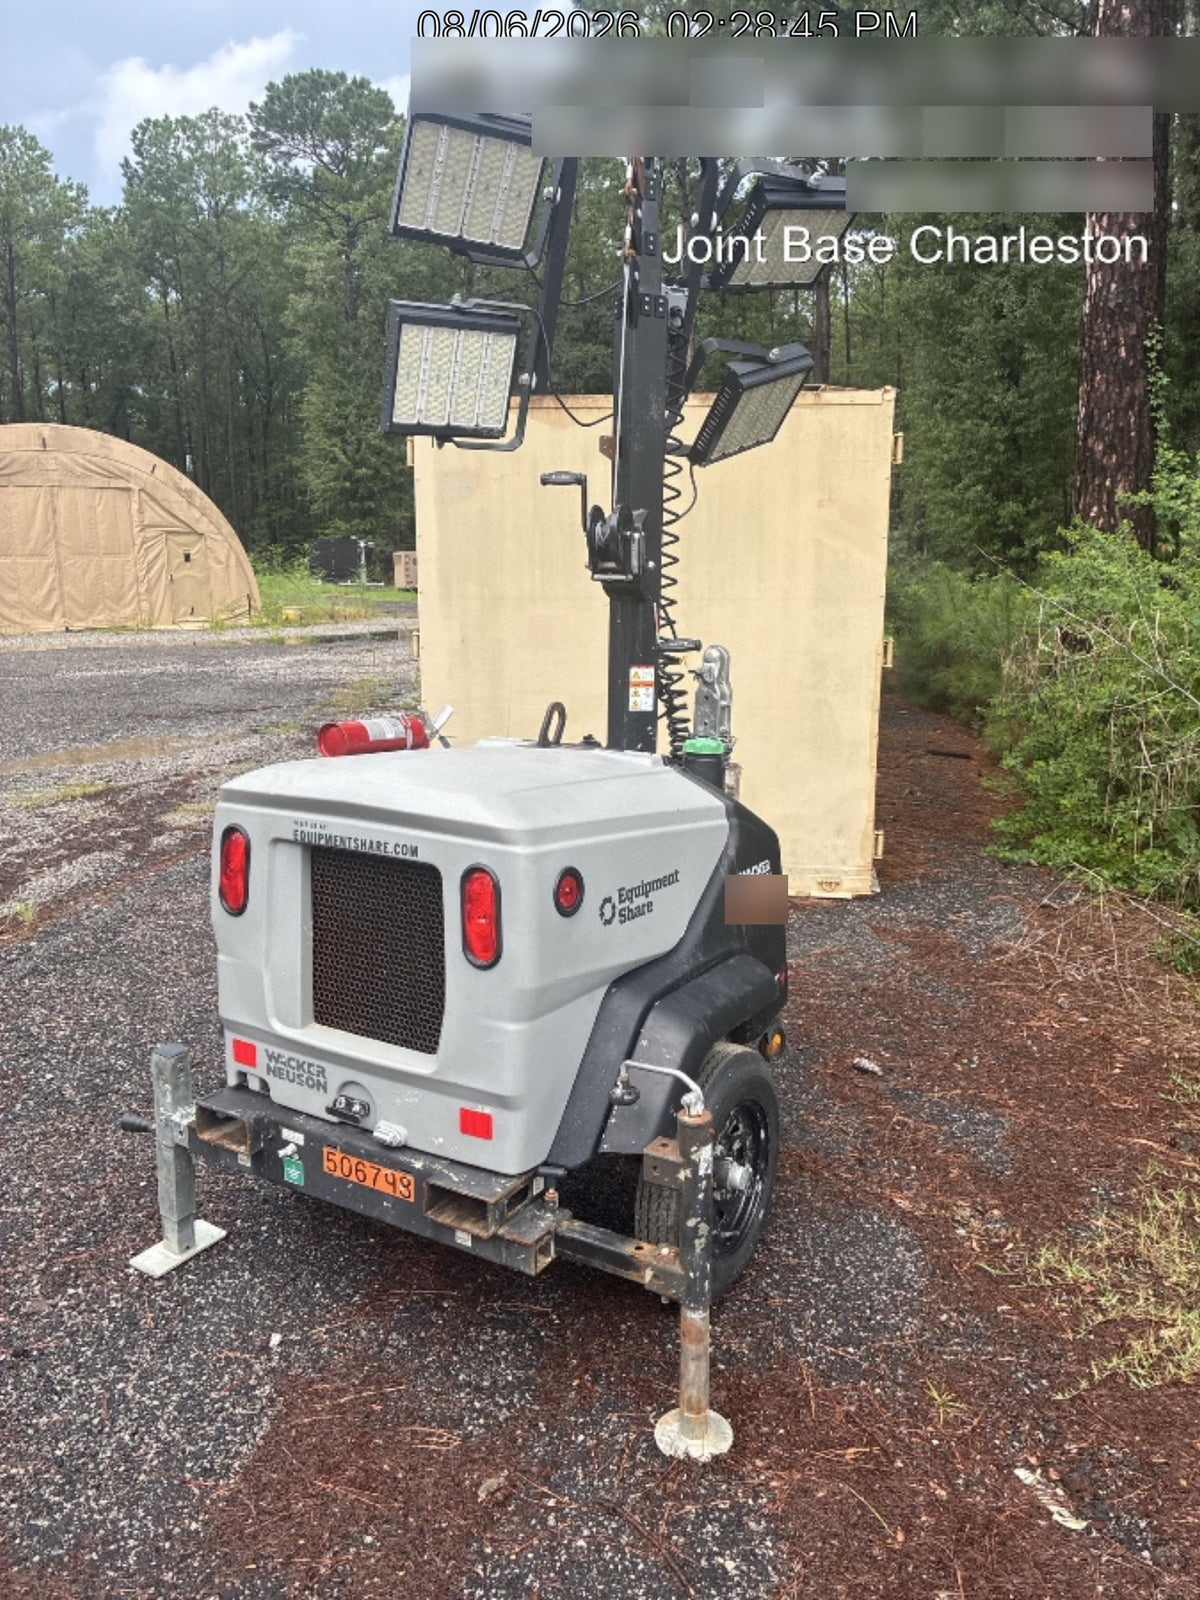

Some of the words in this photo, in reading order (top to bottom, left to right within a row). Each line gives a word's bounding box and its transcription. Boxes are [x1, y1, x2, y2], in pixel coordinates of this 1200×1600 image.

[293, 829, 419, 858] EQUIPMENTSHARE.COM
[617, 869, 680, 905] Equipment
[618, 900, 654, 925] Share
[264, 1048, 327, 1080] WACKER
[266, 1062, 328, 1094] NEUSON
